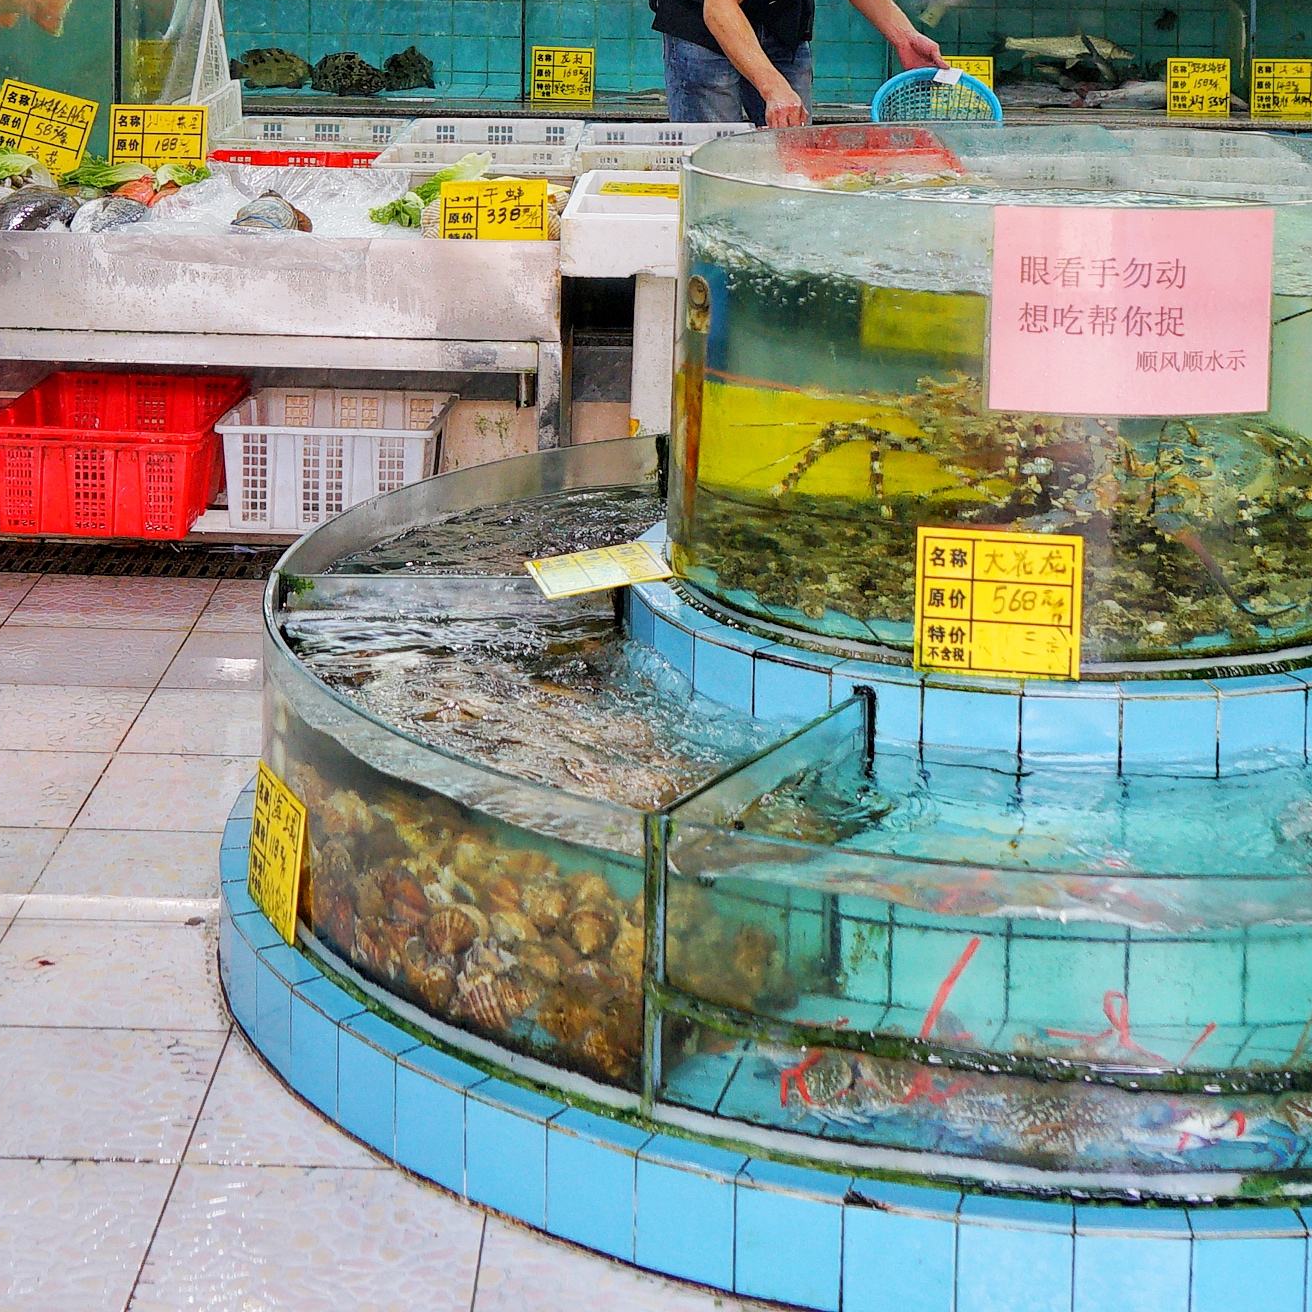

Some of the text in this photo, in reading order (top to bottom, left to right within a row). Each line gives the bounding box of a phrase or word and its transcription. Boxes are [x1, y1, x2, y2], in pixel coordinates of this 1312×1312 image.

[537, 54, 552, 62] 名称
[537, 69, 551, 77] 原价
[1172, 64, 1187, 74] 名称
[1257, 64, 1272, 74] 名称
[537, 83, 551, 91] 特价
[1172, 80, 1187, 89] 原价
[1257, 80, 1272, 89] 原价
[5, 91, 31, 107] 名称
[1257, 95, 1272, 103] 特价
[117, 115, 142, 128] 名称
[116, 139, 140, 151] 原价
[448, 212, 473, 224] 原价
[1019, 255, 1187, 290] 眼看手勿动
[1018, 302, 1186, 337] 想吃帮你捉
[1134, 348, 1247, 374] 顺风顺水示
[929, 546, 1067, 577] 名称 大花龙
[927, 588, 966, 609] 原价
[927, 624, 966, 644] 特价
[927, 646, 965, 662] 不含税
[259, 778, 270, 806] 名称
[254, 818, 266, 845] 原价
